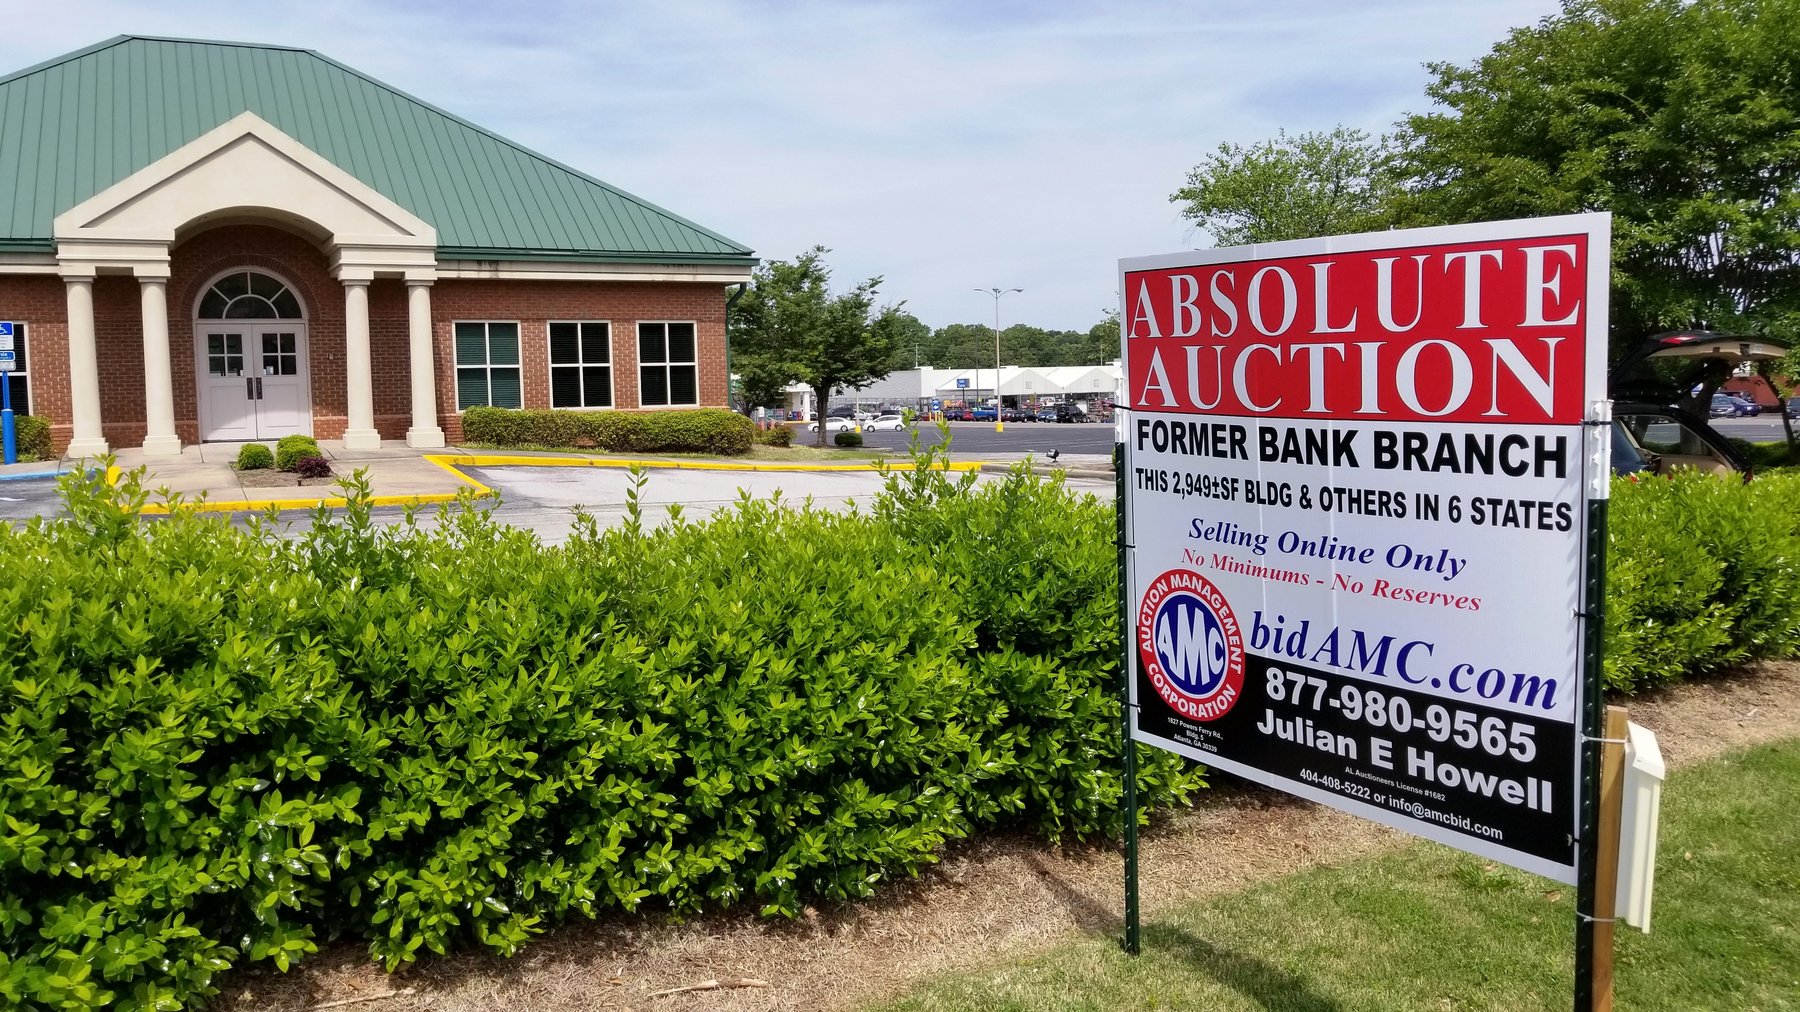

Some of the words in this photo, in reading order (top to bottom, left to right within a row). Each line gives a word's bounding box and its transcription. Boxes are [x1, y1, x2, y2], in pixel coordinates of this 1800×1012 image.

[1128, 244, 1580, 338] ABSOLUTE
[1137, 337, 1566, 419] AUCTION
[1137, 419, 1249, 460] FORMER
[1259, 426, 1360, 468] BANK
[1373, 430, 1567, 478] BRANCH
[1135, 468, 1168, 493] THIS
[1172, 471, 1239, 501] 2,949±SF
[1244, 479, 1292, 507] BLDG
[1299, 484, 1312, 510] &
[1319, 486, 1407, 518] OTHERS
[1415, 493, 1439, 521] IN
[1448, 495, 1462, 523] 6
[1470, 497, 1572, 532] STATES
[1181, 548, 1205, 566] No
[1209, 553, 1310, 586] Minimums
[1331, 573, 1363, 594] No
[1371, 579, 1482, 611] Reserves
[1188, 518, 1269, 556] Selling
[1277, 531, 1375, 564] Online
[1386, 543, 1467, 581] Only
[1141, 579, 1169, 652] AUCTION
[1170, 573, 1242, 675] MANAGEMENT
[1157, 603, 1224, 686] AMC
[1148, 662, 1237, 718] CORPORATION
[1249, 610, 1558, 710] bidAMC.com
[1180, 720, 1198, 731] Powers
[1198, 726, 1212, 737] Ferry
[1193, 740, 1202, 748] GA
[1266, 667, 1537, 763] 877-980-9565
[1256, 708, 1357, 760] Julian
[1370, 736, 1394, 770] E
[1407, 746, 1552, 814] Howell
[1345, 766, 1355, 775] AL
[1355, 769, 1395, 787] Auctioneers
[1396, 782, 1423, 796] License
[1424, 788, 1446, 802] #1682
[1299, 768, 1371, 800] 404-408-5222
[1373, 792, 1386, 804] or
[1388, 794, 1503, 840] info@amcbid.com
